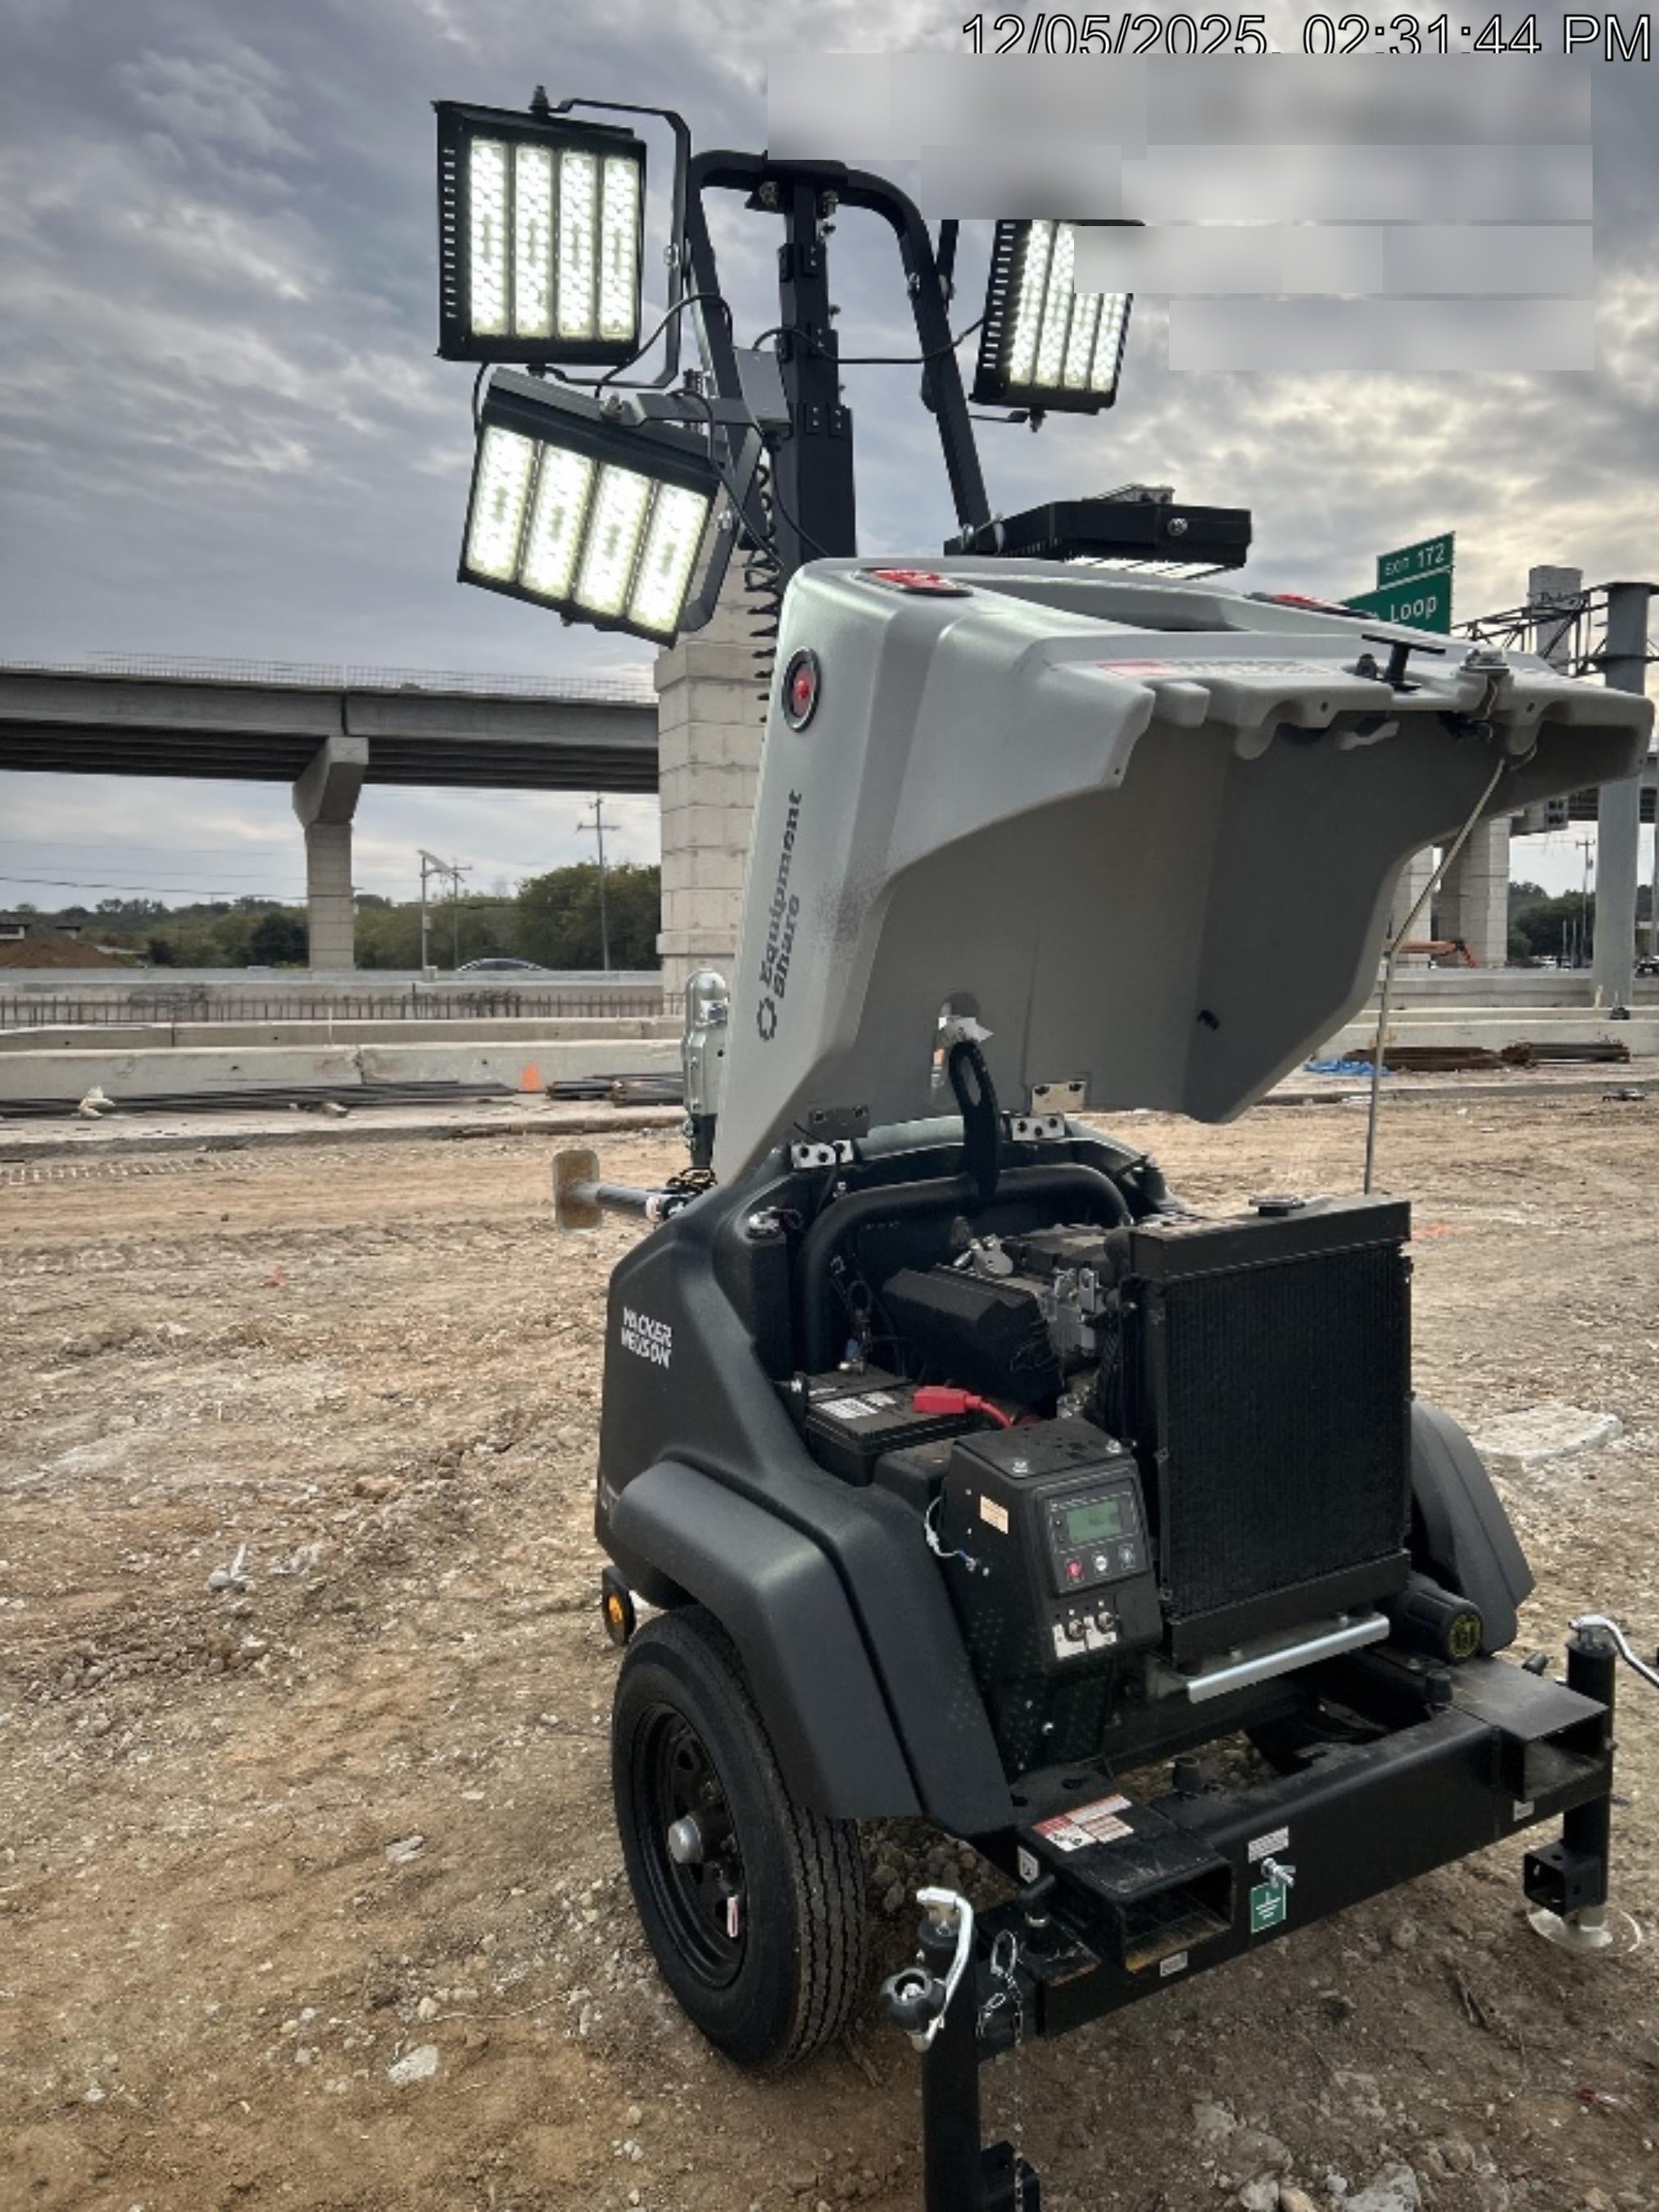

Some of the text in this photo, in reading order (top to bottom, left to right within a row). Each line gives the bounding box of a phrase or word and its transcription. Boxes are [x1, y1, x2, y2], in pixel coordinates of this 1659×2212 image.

[1385, 543, 1445, 576] EXIT 172
[1390, 596, 1437, 623] Loop
